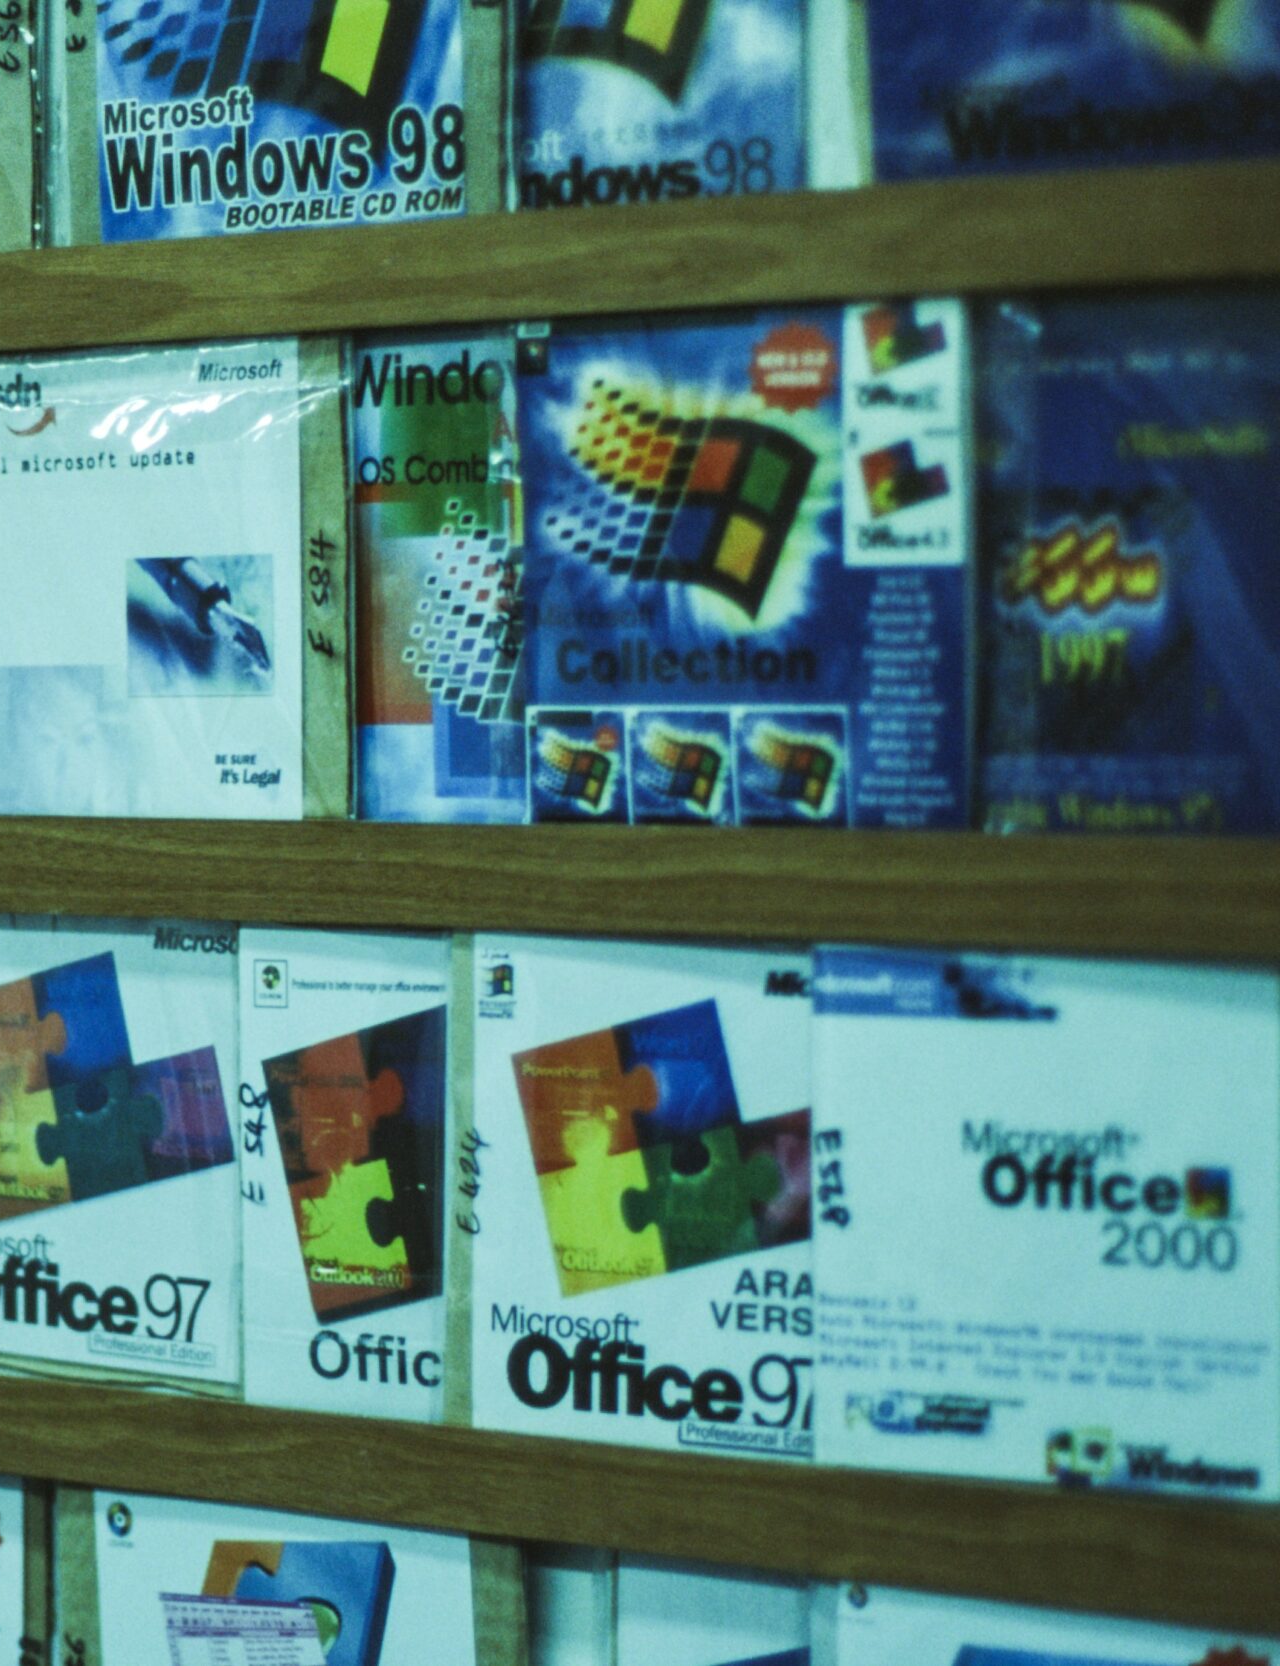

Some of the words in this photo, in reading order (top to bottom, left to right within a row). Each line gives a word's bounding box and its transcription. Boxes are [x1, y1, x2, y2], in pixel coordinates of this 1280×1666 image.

[104, 86, 254, 137] Microsoft
[106, 128, 370, 212] Windows
[390, 102, 466, 184] 98
[702, 136, 774, 196] 98
[225, 196, 356, 230] BOOTABLE
[362, 190, 399, 216] CD
[405, 186, 462, 213] ROM
[197, 357, 283, 384] Microsoft
[21, 452, 117, 474] microsoft
[129, 448, 197, 471] update
[359, 456, 396, 486] OS
[556, 637, 818, 684] Collection
[219, 767, 239, 785] It's
[242, 767, 281, 788] Legal
[230, 753, 257, 766] SURE
[961, 1119, 1126, 1159] Microsoft
[982, 1151, 1182, 1216] Office
[1101, 1218, 1239, 1273] 2000
[733, 1269, 813, 1299] ARA
[144, 1272, 211, 1343] 97
[491, 1303, 634, 1343] Microsoft
[710, 1301, 813, 1336] VERS
[92, 1335, 168, 1357] Professional
[170, 1344, 214, 1362] Edition
[309, 1328, 441, 1388] Offic
[506, 1333, 744, 1423] Office
[685, 1423, 778, 1448] Professional
